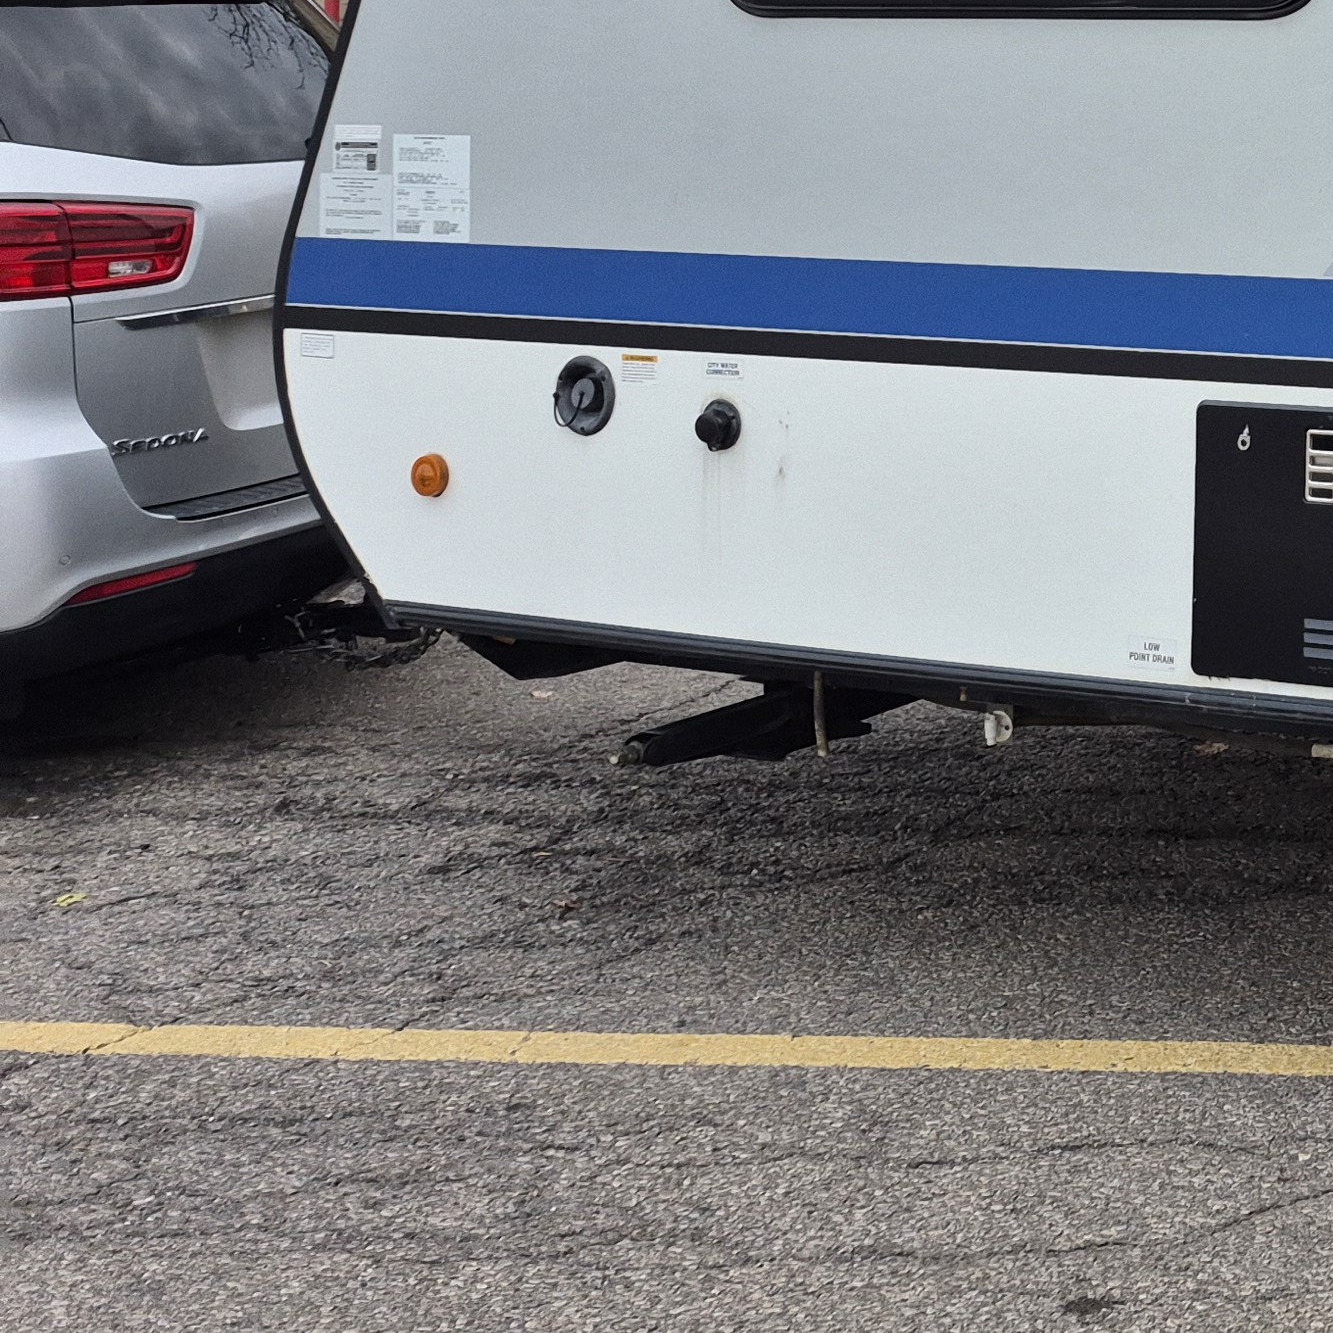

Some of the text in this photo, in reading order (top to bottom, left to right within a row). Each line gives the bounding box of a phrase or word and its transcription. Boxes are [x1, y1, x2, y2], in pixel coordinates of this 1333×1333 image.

[111, 428, 209, 457] SEDONA
[1143, 641, 1161, 651] LOW
[1129, 651, 1175, 665] POINT DRAIN
